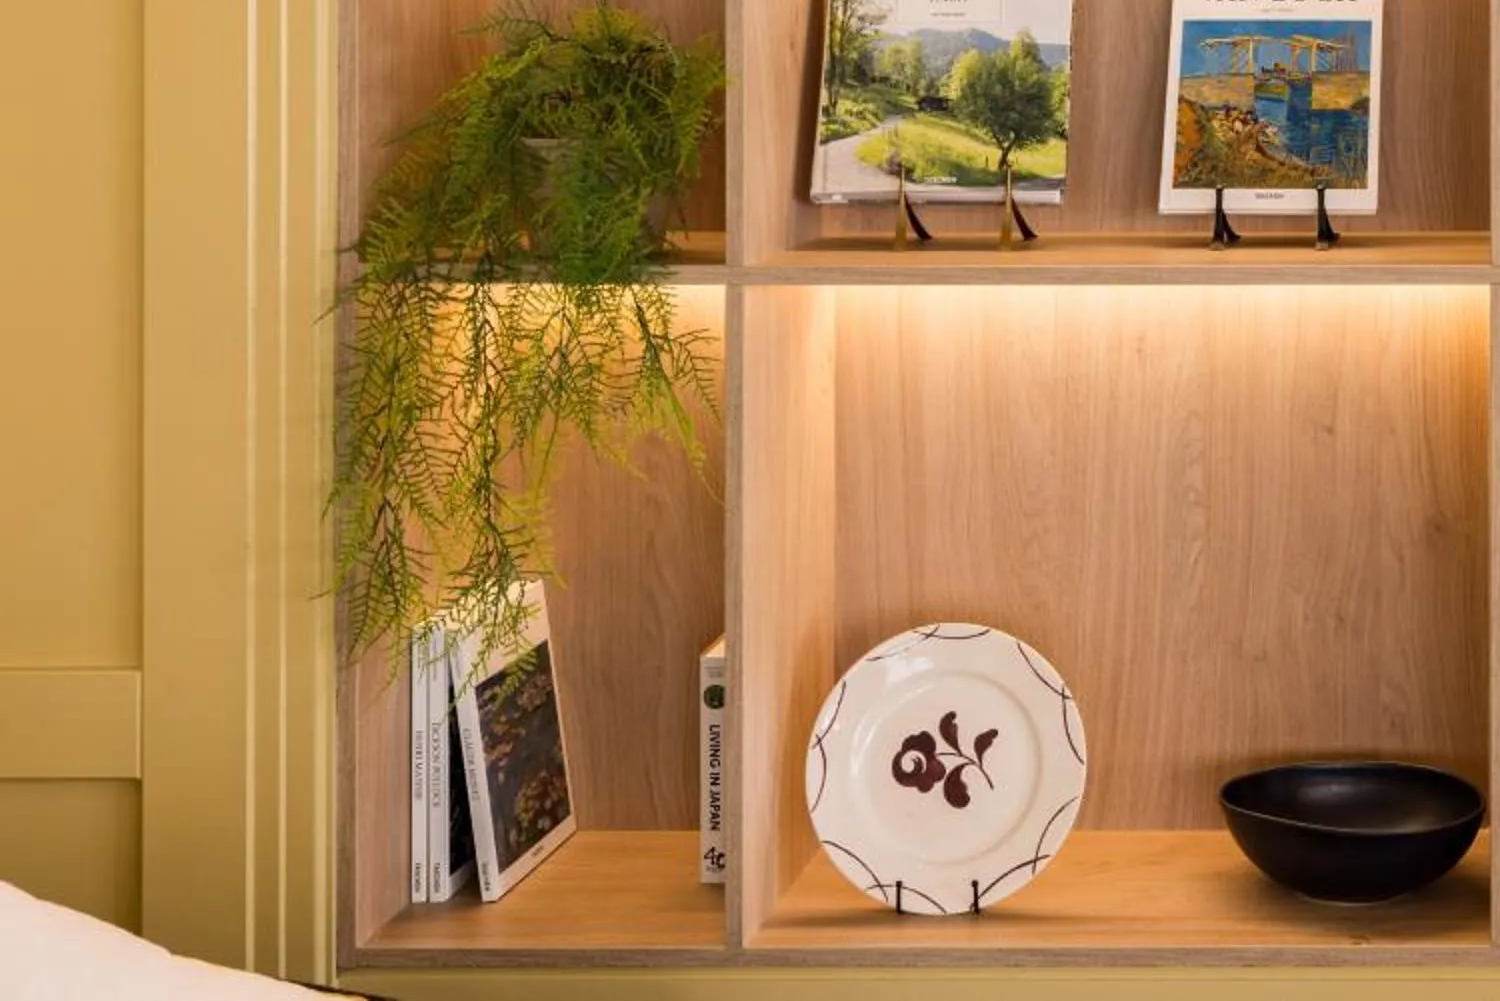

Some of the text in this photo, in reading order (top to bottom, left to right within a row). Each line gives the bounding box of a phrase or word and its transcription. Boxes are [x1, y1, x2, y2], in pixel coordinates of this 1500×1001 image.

[708, 723, 722, 832] LIVING IN JAPAN
